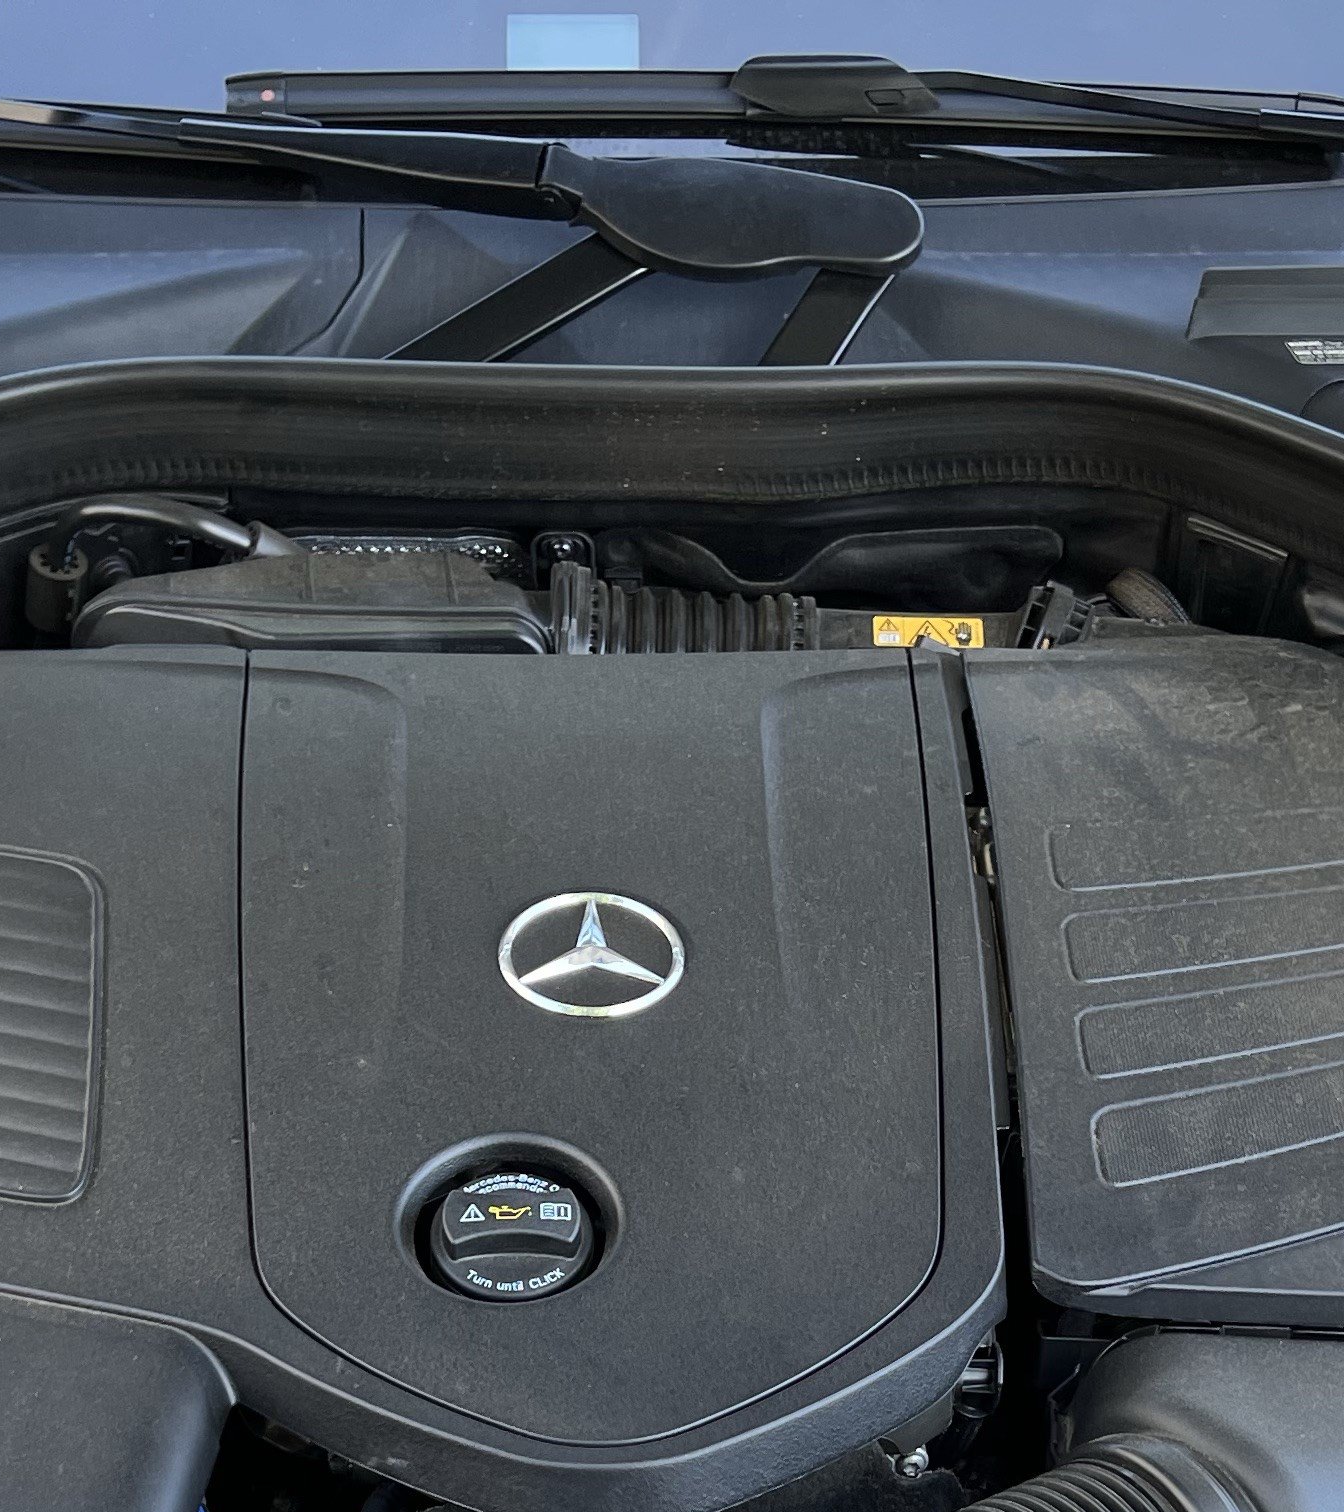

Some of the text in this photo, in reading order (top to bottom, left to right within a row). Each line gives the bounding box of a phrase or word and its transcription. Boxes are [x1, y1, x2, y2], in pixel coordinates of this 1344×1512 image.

[465, 1267, 566, 1292] Turn until CLICK
